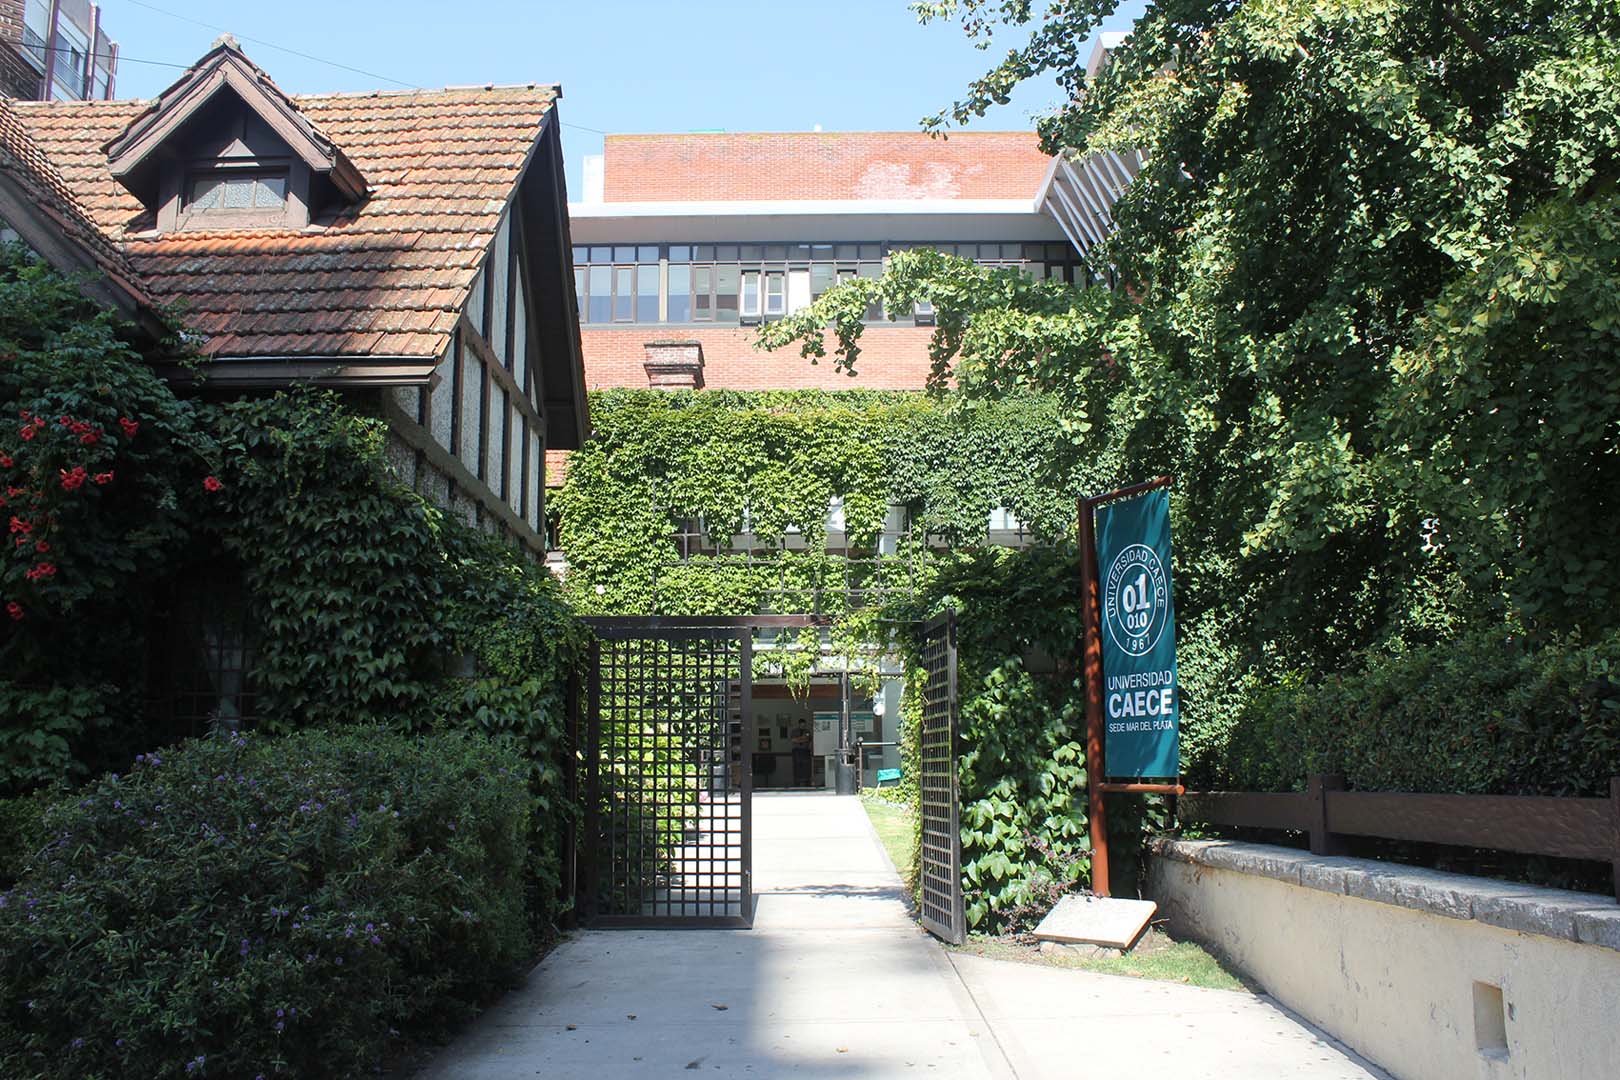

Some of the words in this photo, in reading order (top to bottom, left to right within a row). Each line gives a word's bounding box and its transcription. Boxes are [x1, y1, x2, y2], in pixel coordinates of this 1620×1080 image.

[1108, 549, 1148, 618] UNIVERSIDAD
[1148, 558, 1165, 608] CAECE
[1122, 573, 1151, 613] 01
[1127, 611, 1148, 629] 010
[1126, 633, 1151, 651] 1967
[1108, 670, 1173, 690] UNIVERSIDAD
[1109, 688, 1173, 718] CAECE
[1109, 722, 1125, 732] SEDE
[1126, 721, 1140, 731] MAR
[1140, 721, 1152, 731] DEL
[1153, 719, 1173, 730] PLATA
